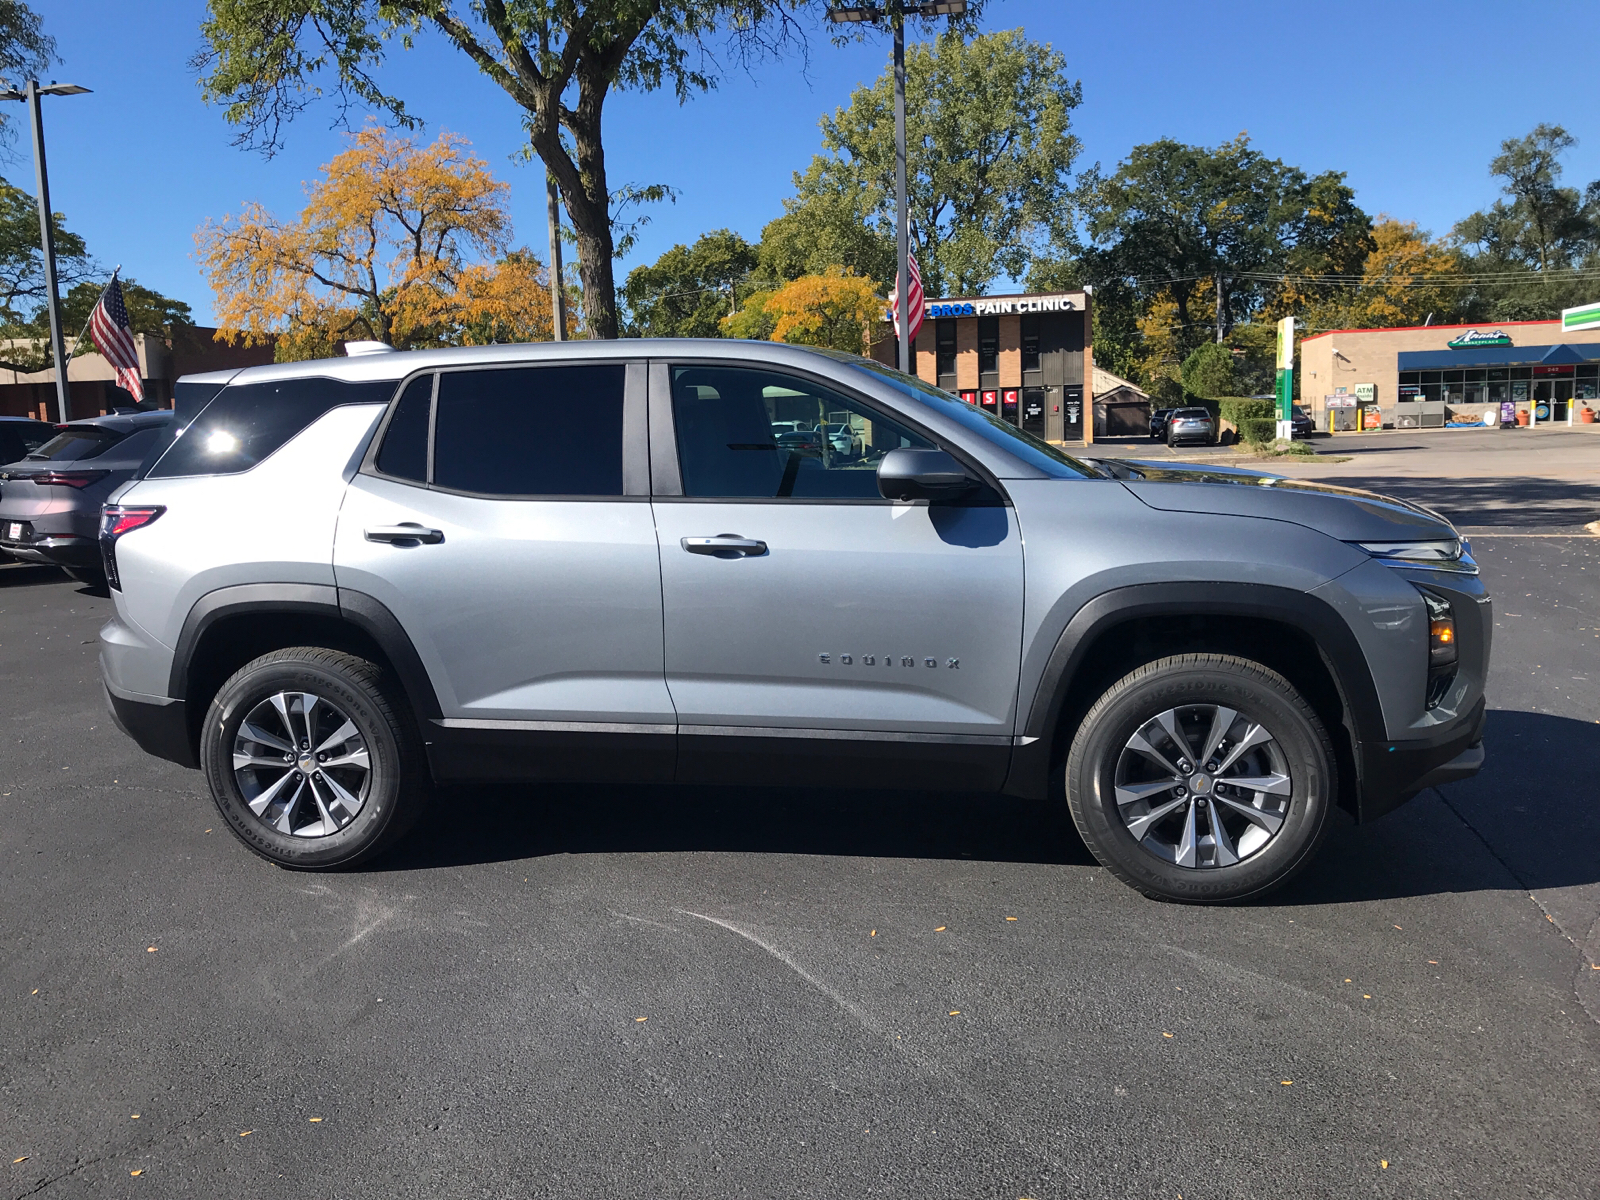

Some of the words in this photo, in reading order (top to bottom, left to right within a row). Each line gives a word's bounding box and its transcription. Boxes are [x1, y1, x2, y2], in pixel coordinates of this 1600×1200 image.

[931, 303, 973, 316] BROS
[976, 301, 1012, 315] PAIN
[1017, 297, 1070, 311] CLINIC
[1452, 330, 1508, 344] Anna's
[818, 651, 960, 670] EQUINOX
[303, 673, 367, 719] Firestone
[231, 813, 294, 858] Firestone
